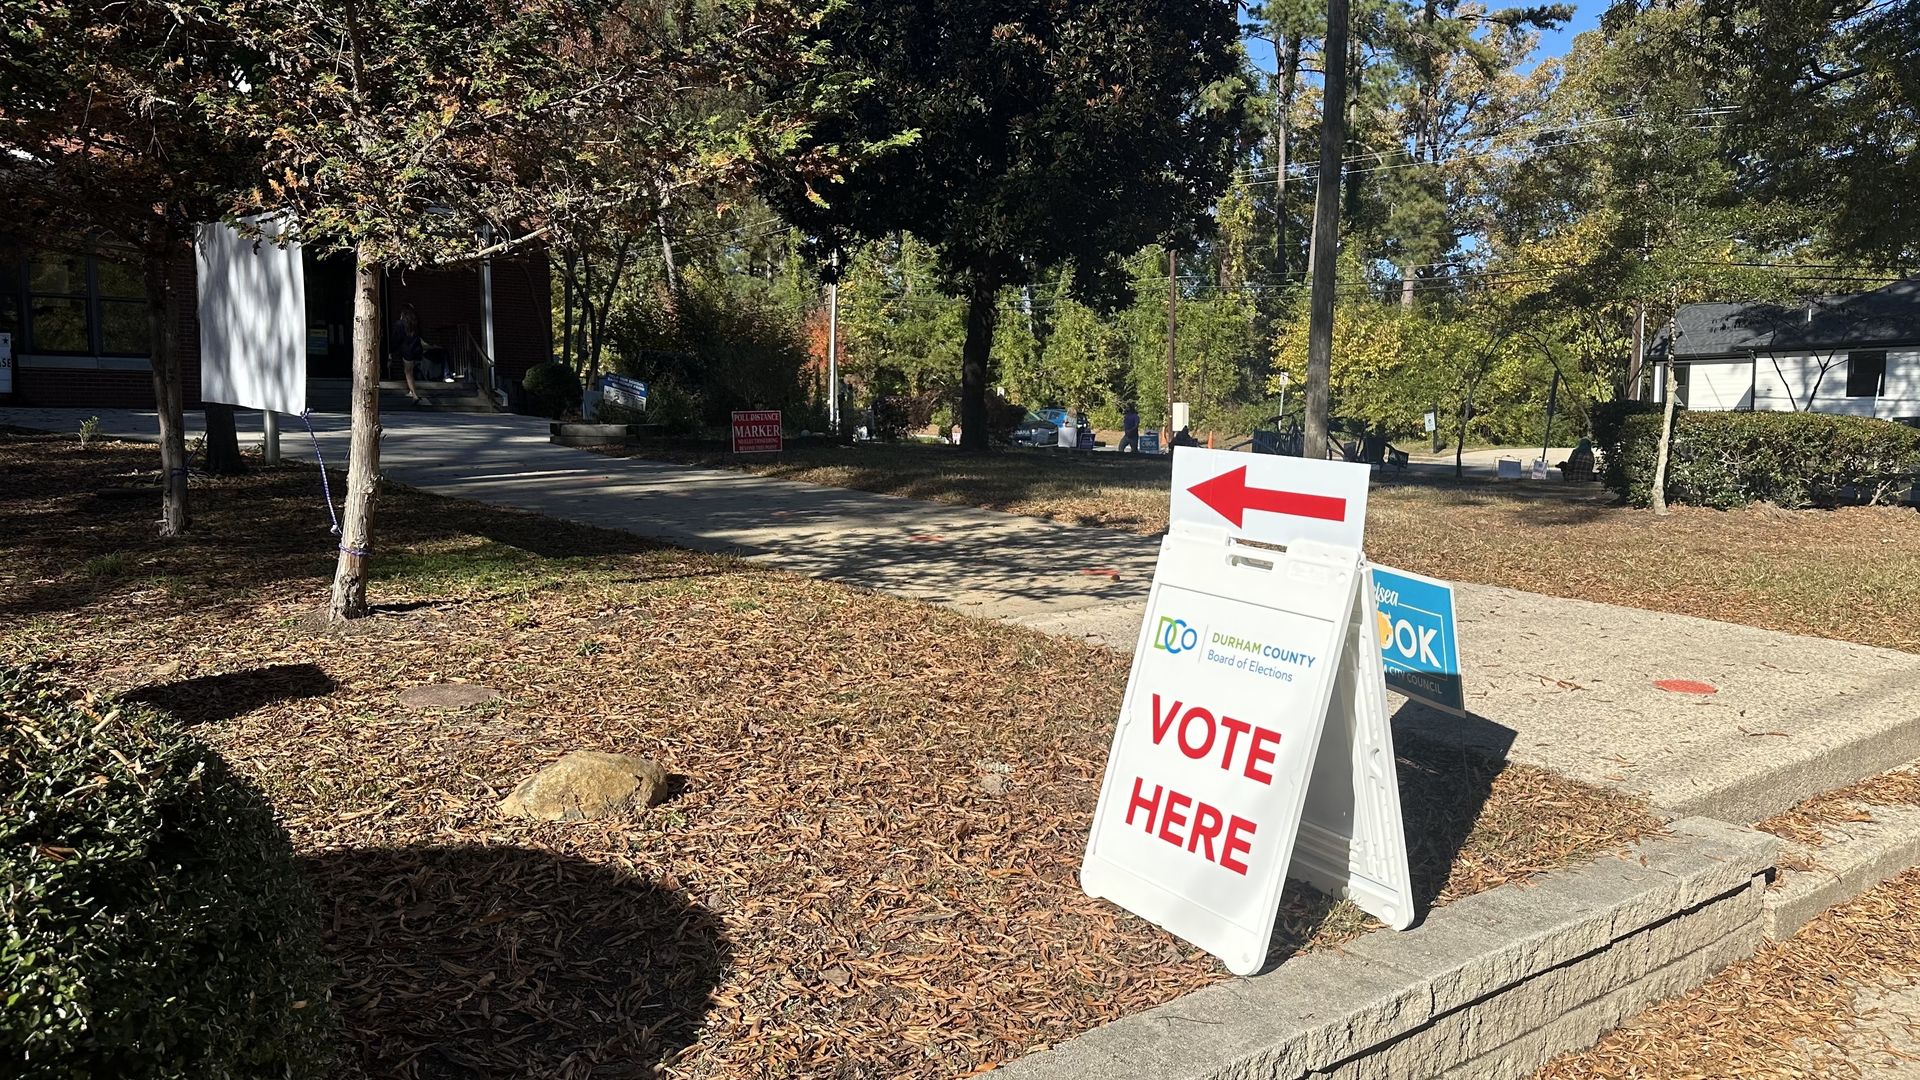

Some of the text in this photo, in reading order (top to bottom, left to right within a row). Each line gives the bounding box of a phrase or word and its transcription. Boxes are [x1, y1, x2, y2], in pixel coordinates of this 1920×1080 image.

[734, 413, 779, 421] POLL DISTANCE
[735, 424, 780, 437] MARKER
[1374, 581, 1399, 607] lsea
[1212, 632, 1316, 668] DURHAM COUNTY
[1207, 650, 1293, 682] Board of Elections
[1389, 666, 1405, 679] CITY
[1406, 673, 1442, 695] COUNCIL
[1152, 693, 1282, 785] VOTE
[1125, 776, 1257, 876] HERE
